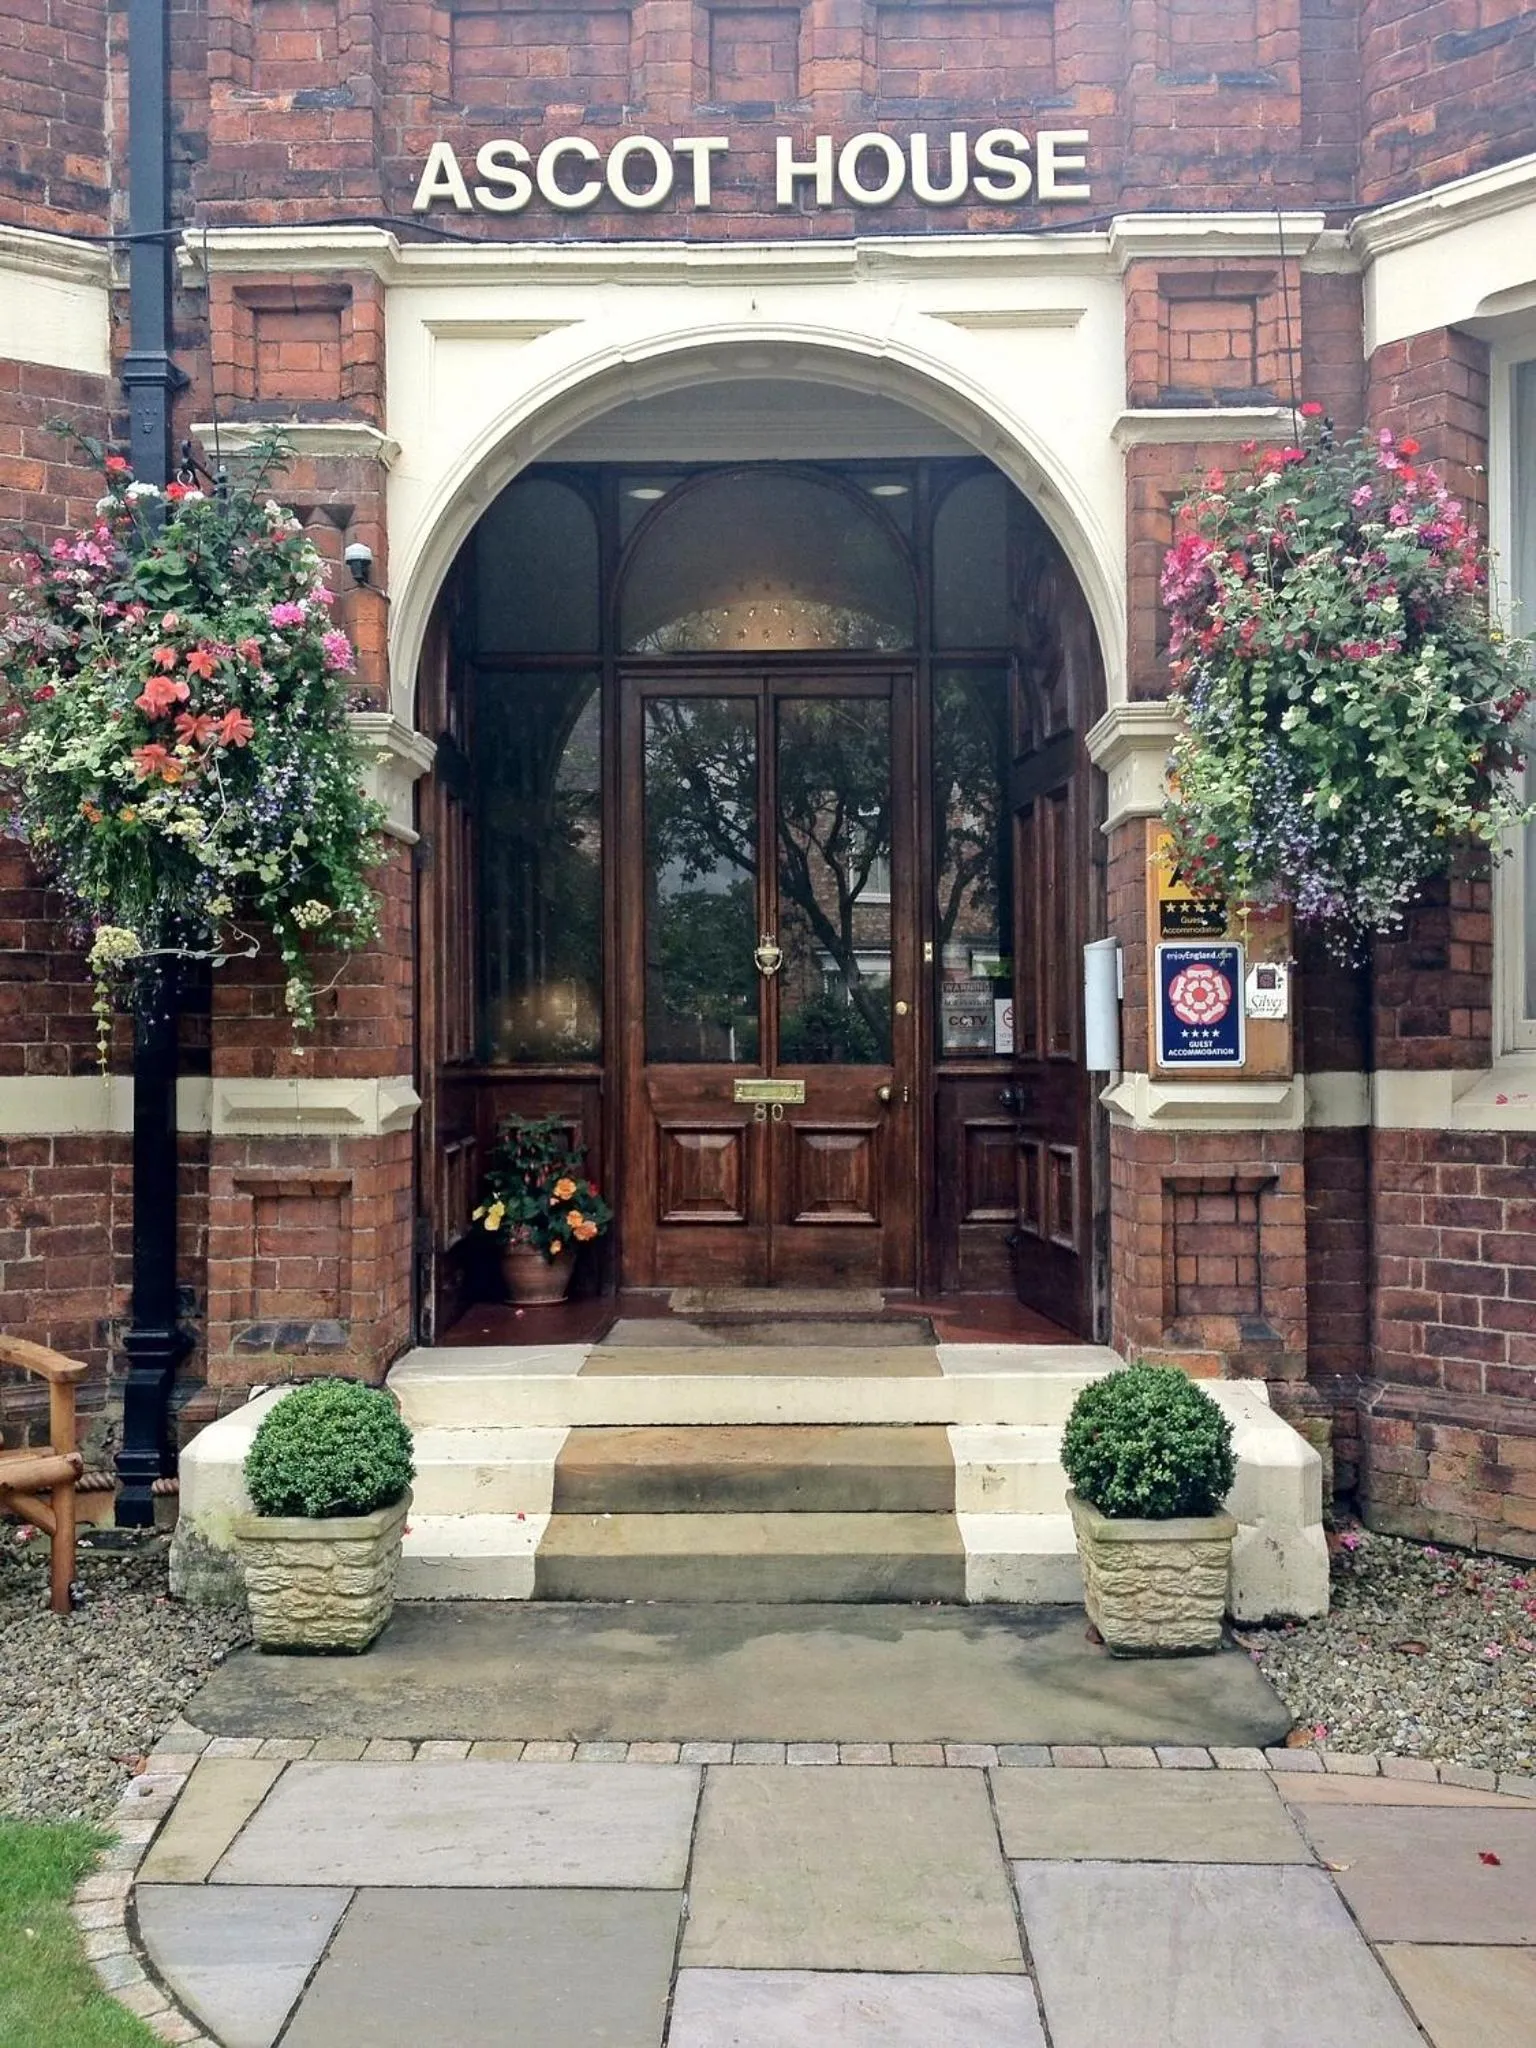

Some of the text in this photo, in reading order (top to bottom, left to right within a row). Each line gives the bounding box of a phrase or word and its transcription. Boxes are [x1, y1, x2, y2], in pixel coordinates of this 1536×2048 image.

[412, 128, 1091, 213] ASCOT HOUSE
[948, 1016, 988, 1026] CCTV
[1168, 1048, 1234, 1056] ACCOMMODATION
[754, 1103, 784, 1122] 80
